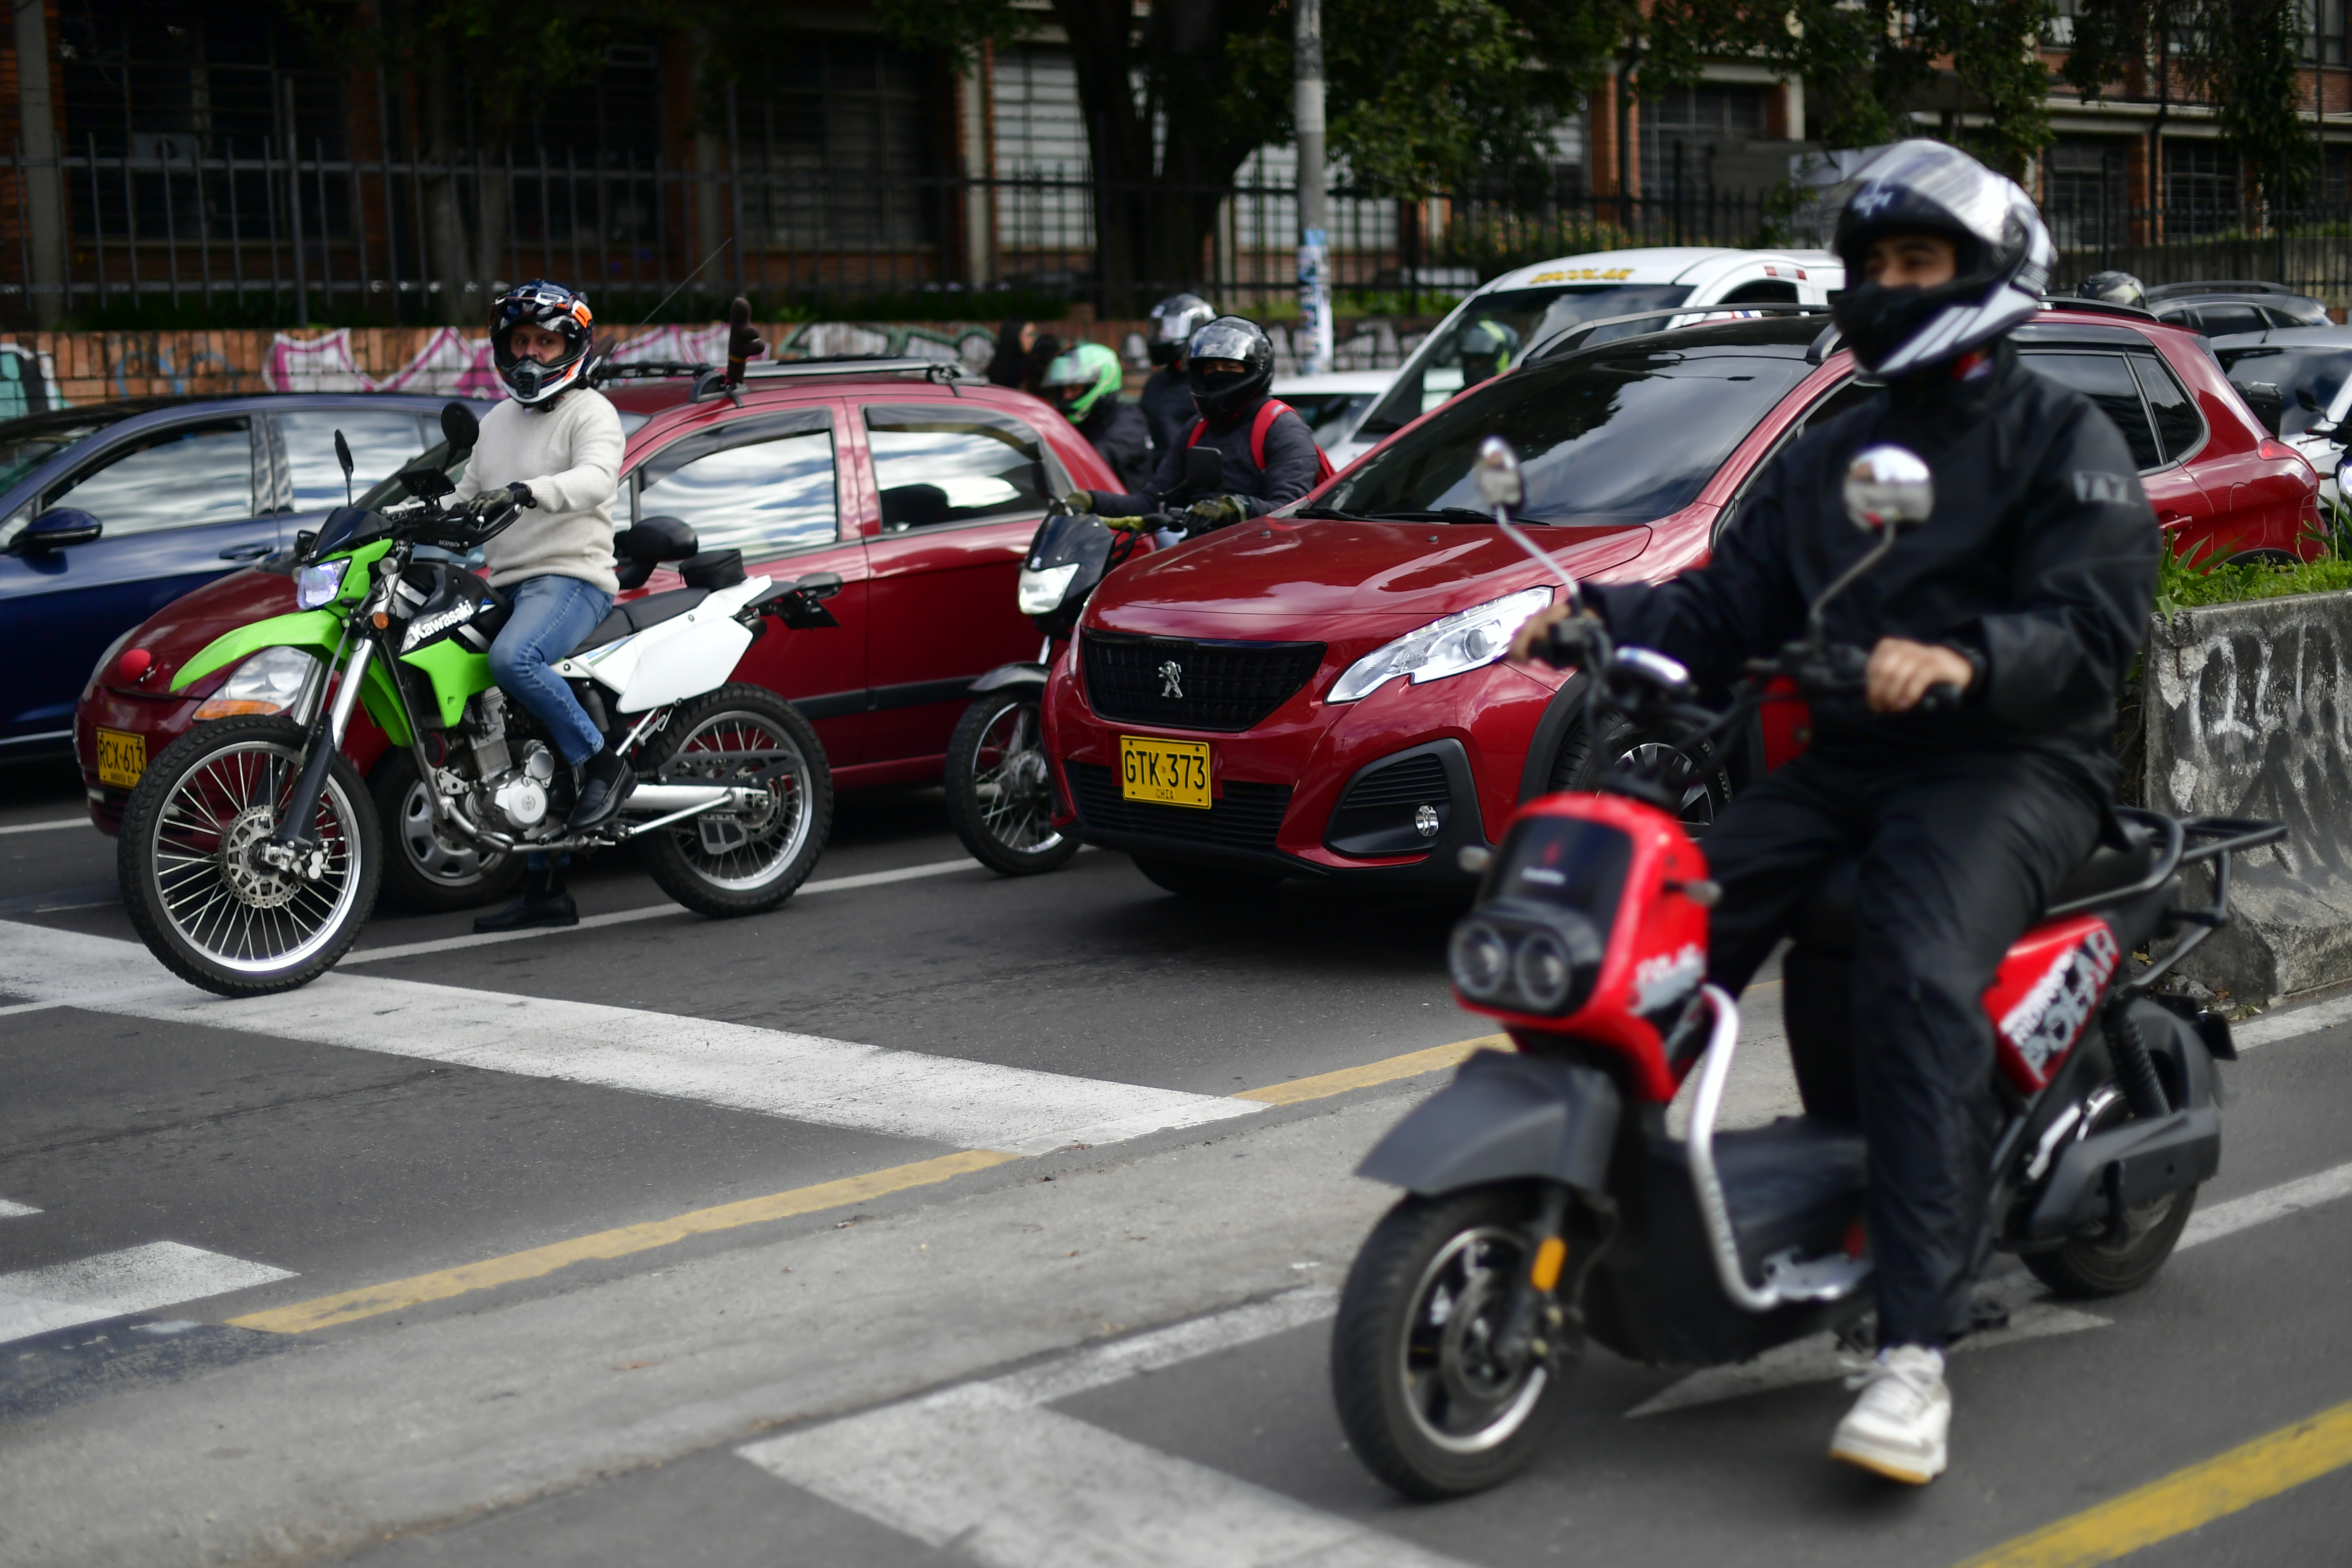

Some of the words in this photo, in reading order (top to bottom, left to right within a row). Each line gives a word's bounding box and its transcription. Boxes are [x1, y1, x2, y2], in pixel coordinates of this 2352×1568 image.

[409, 599, 474, 642] Kawasaki
[99, 740, 120, 770] RCX
[123, 744, 144, 774] 613
[1125, 750, 1161, 786] GTK
[1166, 753, 1205, 789] 373
[1156, 788, 1174, 799] CHIA
[2020, 928, 2119, 1083] POLAR
